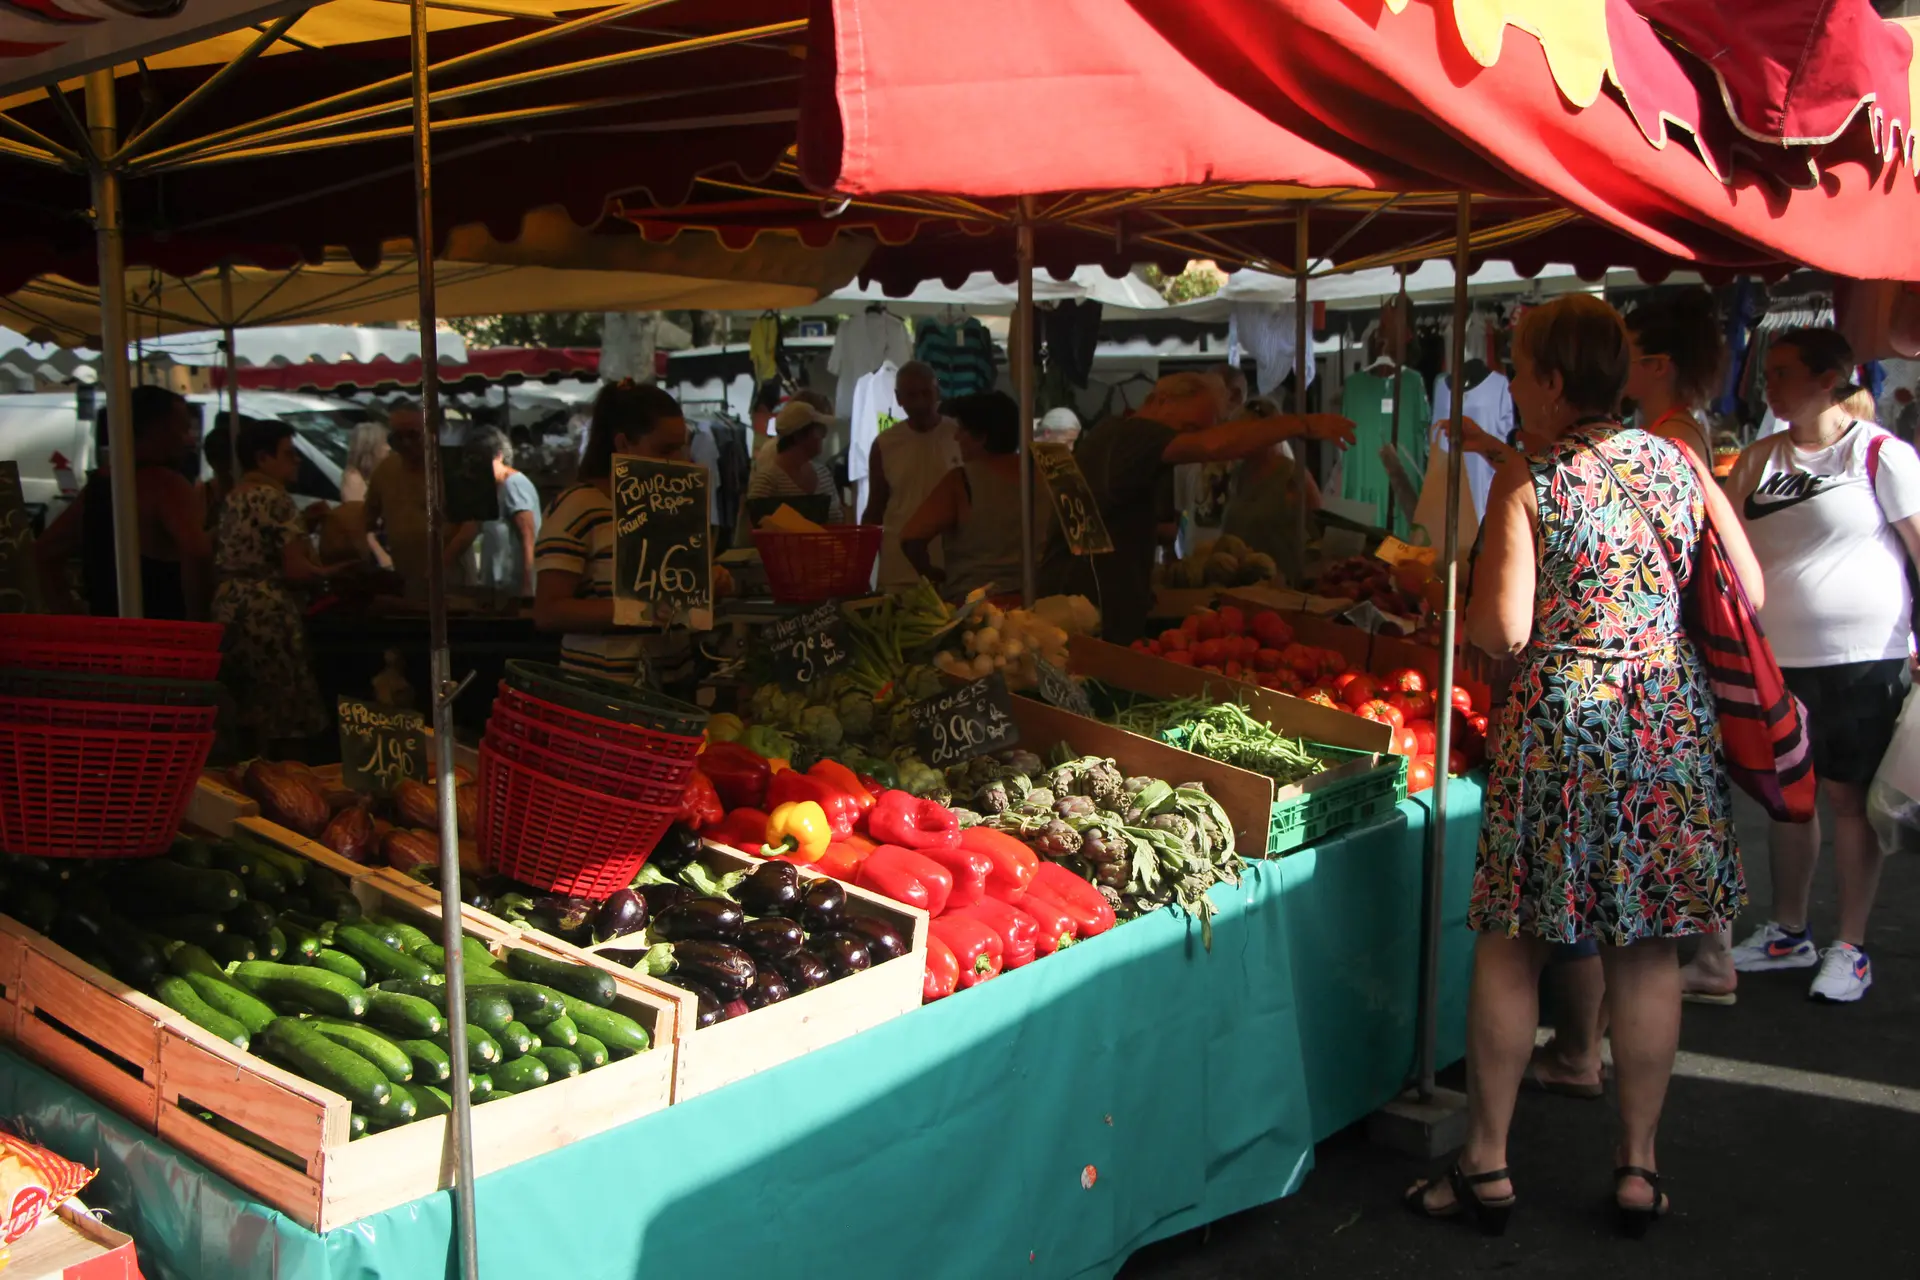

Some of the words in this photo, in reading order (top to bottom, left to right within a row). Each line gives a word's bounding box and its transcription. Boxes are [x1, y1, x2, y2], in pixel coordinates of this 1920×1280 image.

[616, 473, 704, 506] POIVRONS
[1756, 471, 1831, 497] NIKE
[932, 714, 986, 764] 2,90
